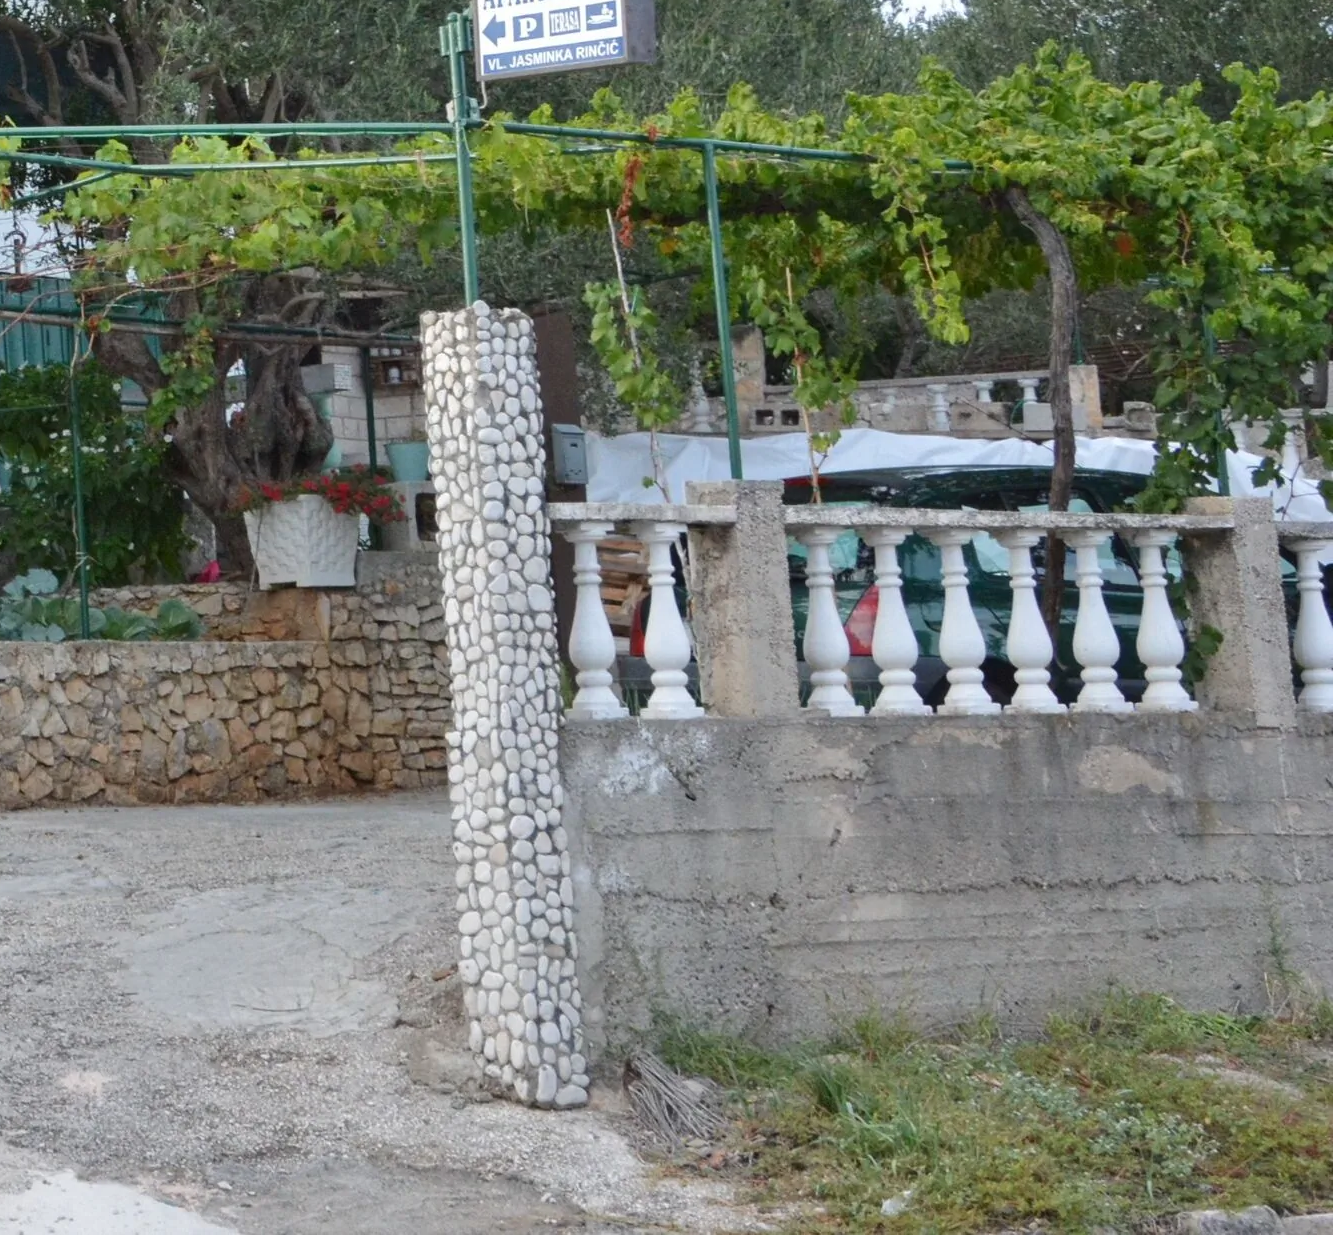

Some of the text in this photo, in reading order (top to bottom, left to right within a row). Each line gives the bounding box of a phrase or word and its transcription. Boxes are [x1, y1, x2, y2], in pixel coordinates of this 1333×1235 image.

[519, 17, 537, 38] P
[488, 39, 619, 71] VL. JASMINKA RINČIĆ
